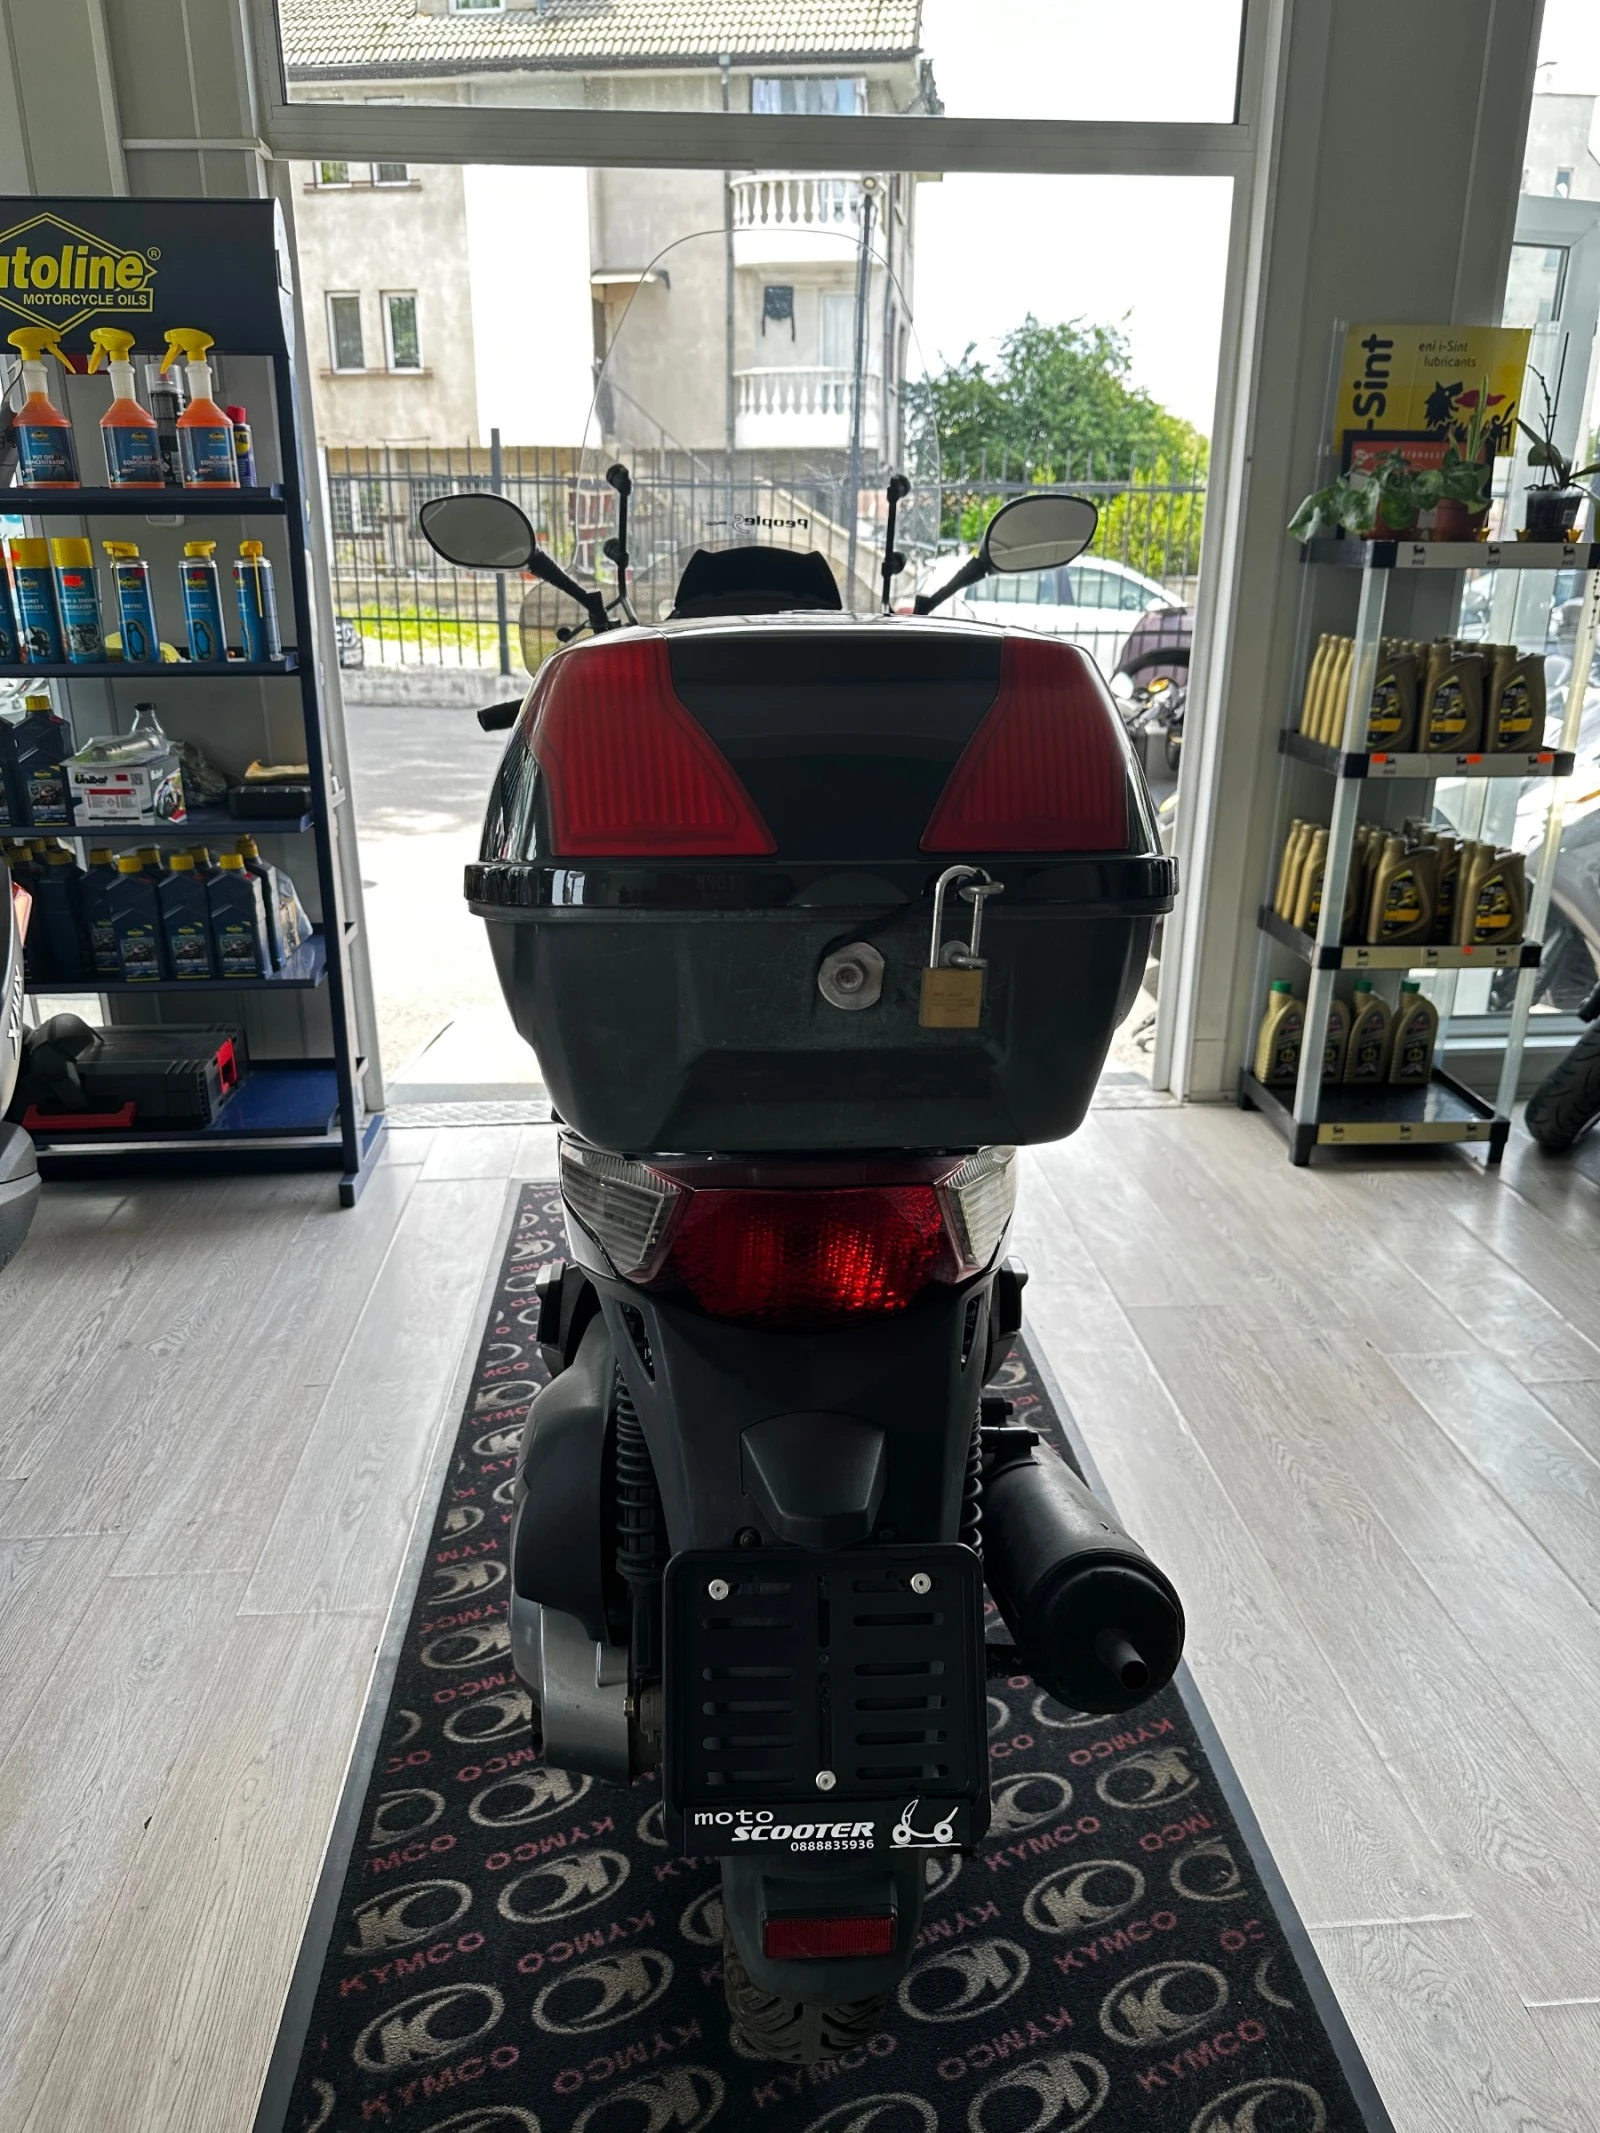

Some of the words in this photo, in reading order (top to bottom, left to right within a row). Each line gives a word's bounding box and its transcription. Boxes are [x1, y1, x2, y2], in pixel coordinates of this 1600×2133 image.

[23, 293, 114, 305] MOTORCYCLE
[117, 294, 147, 306] OILS
[1418, 340, 1436, 352] eni
[1438, 339, 1468, 352] i-Sint
[1423, 354, 1477, 368] lubricants
[1069, 1718, 1175, 1766] KYMCO
[485, 1816, 615, 1871] KYMCO
[694, 1809, 774, 1826] moto
[731, 1822, 875, 1842] SCOOTER
[984, 1816, 1101, 1872] KYMCO
[790, 1840, 875, 1852] 0888835936
[340, 1932, 485, 1997] KYMCO
[517, 1910, 655, 1974] KYMCO
[1053, 1910, 1177, 1974] KYMCO
[552, 2018, 702, 2095] KYMCO
[937, 2007, 1074, 2082] KYMCO
[1136, 2018, 1267, 2094] KYMCO
[361, 2043, 520, 2121] KYMCO
